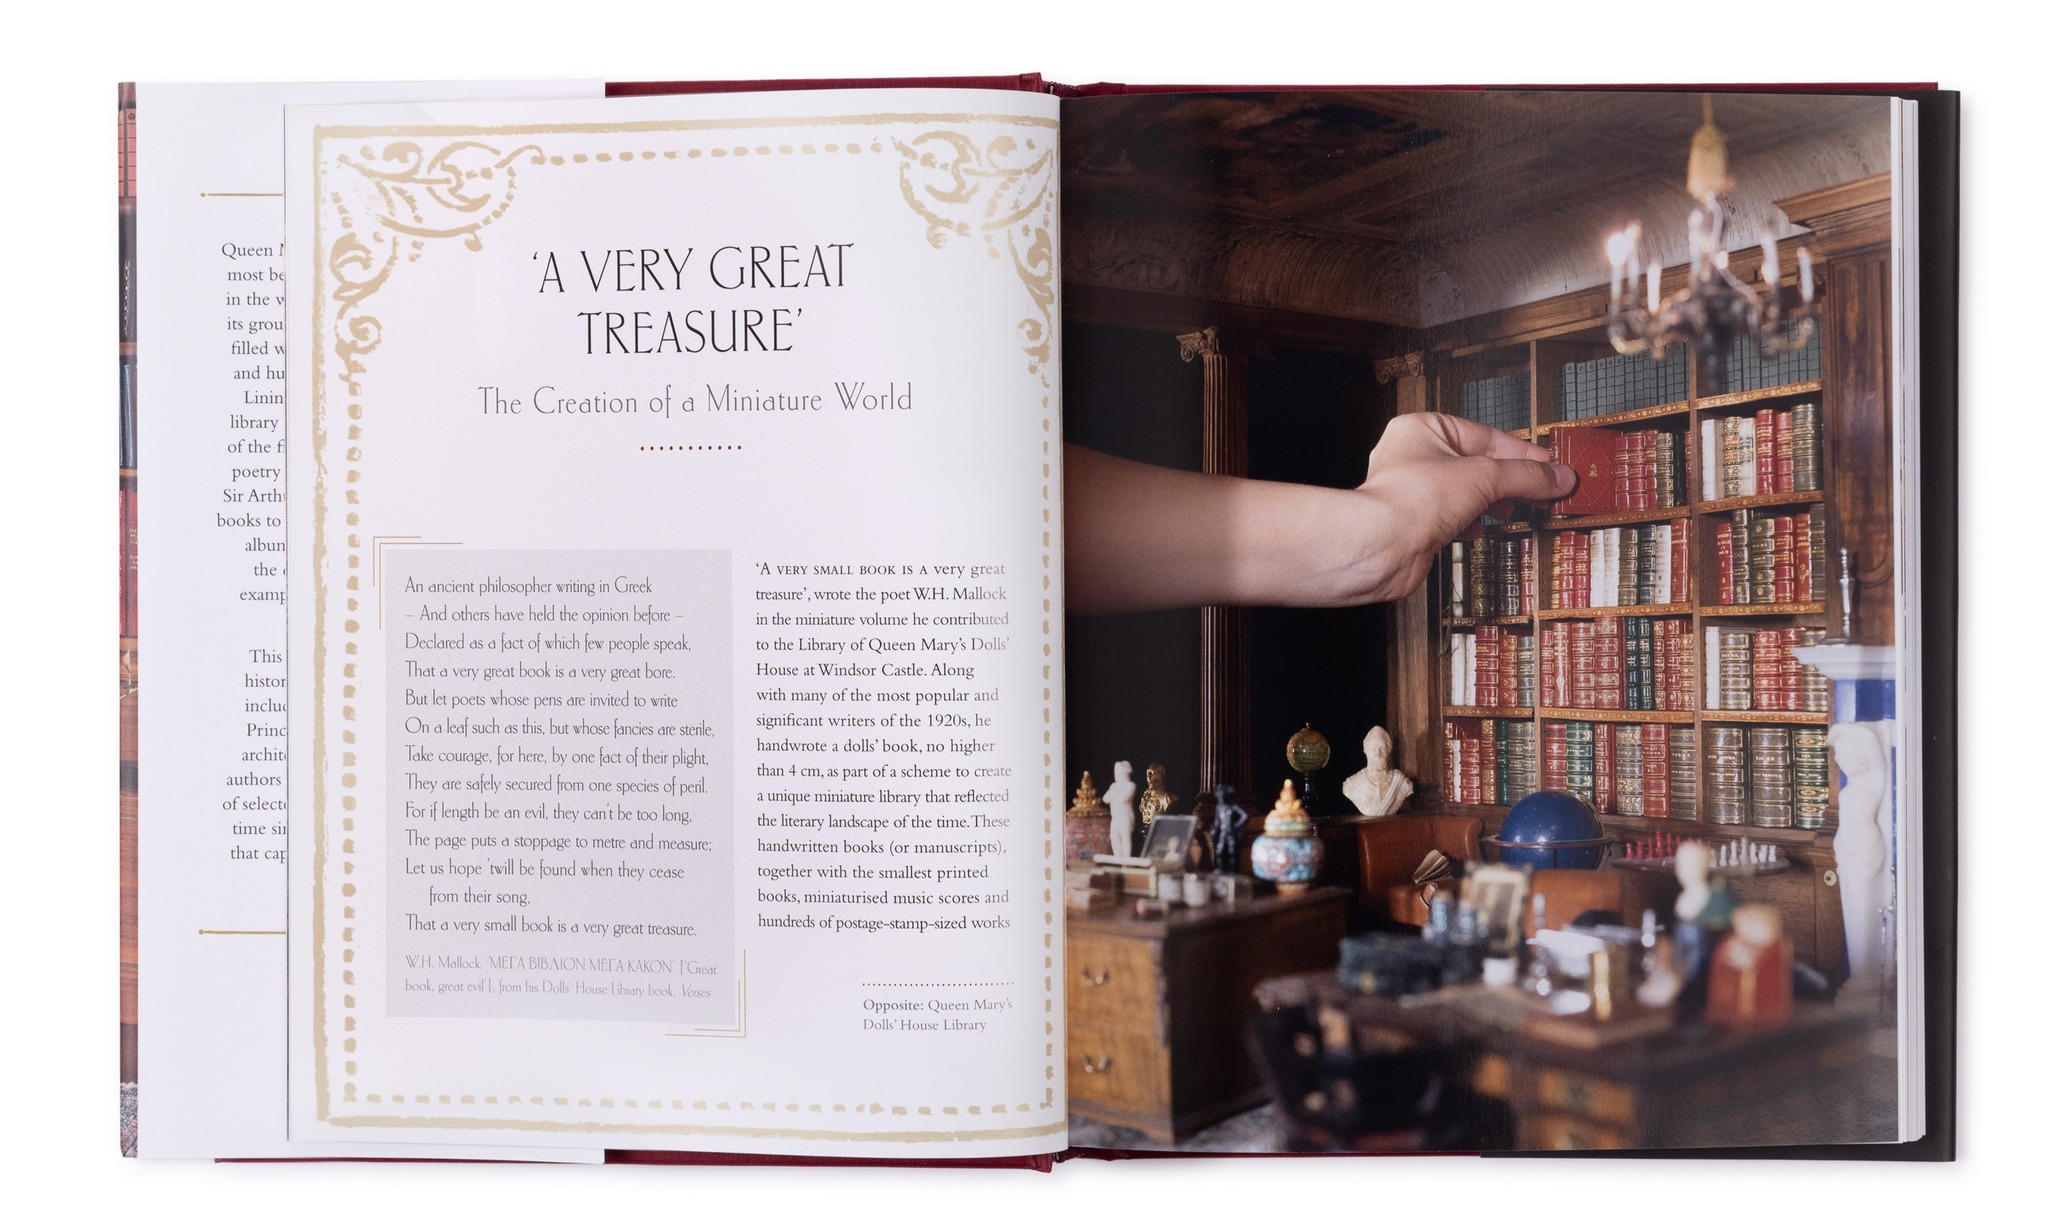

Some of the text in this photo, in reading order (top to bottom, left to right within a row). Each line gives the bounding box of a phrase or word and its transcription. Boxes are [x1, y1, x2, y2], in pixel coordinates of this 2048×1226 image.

[221, 242, 273, 260] Queen
[227, 270, 264, 281] most
[579, 247, 693, 293] VERY
[709, 242, 854, 290] GREAT
[225, 291, 241, 305] in
[246, 291, 270, 306] the
[226, 315, 284, 336] its grou
[230, 339, 269, 355] filled
[233, 364, 260, 379] and
[243, 389, 284, 404] Linin
[477, 381, 911, 418] The Creation of a Miniature World
[229, 413, 279, 433] library
[227, 438, 245, 453] of
[247, 438, 271, 453] the
[231, 466, 281, 483] poetry
[222, 488, 286, 502] Sir Arth
[216, 512, 281, 527] books to
[253, 561, 277, 576] the
[775, 565, 808, 575] VERY
[813, 564, 854, 575] SMALL
[858, 564, 896, 575] BOOK
[901, 564, 913, 575] IS
[918, 564, 928, 575] A
[932, 565, 965, 579] very
[970, 564, 1005, 579] great
[404, 575, 652, 597] An ancient philosopher writing in Greek
[813, 589, 851, 600] wrote
[855, 586, 876, 600] the
[880, 589, 911, 604] poet
[912, 586, 949, 600] W.H.
[952, 585, 1007, 600] Mallock
[405, 631, 691, 654] Declared as a fact of which few people speak,
[248, 648, 282, 663] This
[755, 662, 974, 680] House at Windsor Castle. Along
[405, 688, 678, 709] But let poets whose pens are invited to write
[755, 712, 991, 730] significant writers of the 1920s, he
[756, 737, 827, 752] handwrote
[829, 742, 838, 752] a
[881, 738, 922, 754] book,
[925, 742, 944, 752] no
[949, 738, 995, 756] higher
[225, 771, 281, 786] authors
[222, 795, 240, 810] of
[232, 820, 266, 835] time
[404, 828, 711, 852] The page puts a stoppage to metre and measure;
[756, 837, 1006, 857] handwritten books (or manuscripts),
[230, 844, 259, 859] that
[757, 863, 989, 883] together with the smallest printed
[429, 884, 530, 907] from their song,
[757, 887, 1009, 905] books, miniaturised music scores and
[757, 912, 1010, 933] hundreds of postage-stamp-sized works
[404, 954, 434, 968] W.H.
[437, 954, 482, 970] Mallock,
[405, 977, 434, 992] book,
[437, 982, 463, 994] great
[498, 978, 521, 995] from
[525, 979, 538, 992] his
[575, 980, 607, 994] House
[611, 981, 645, 999] Library
[647, 982, 675, 997] book,
[681, 983, 711, 998] Verses
[862, 998, 923, 1014] Opposite:
[927, 999, 969, 1013] Queen
[900, 1018, 939, 1030] House
[943, 1018, 986, 1033] Library
